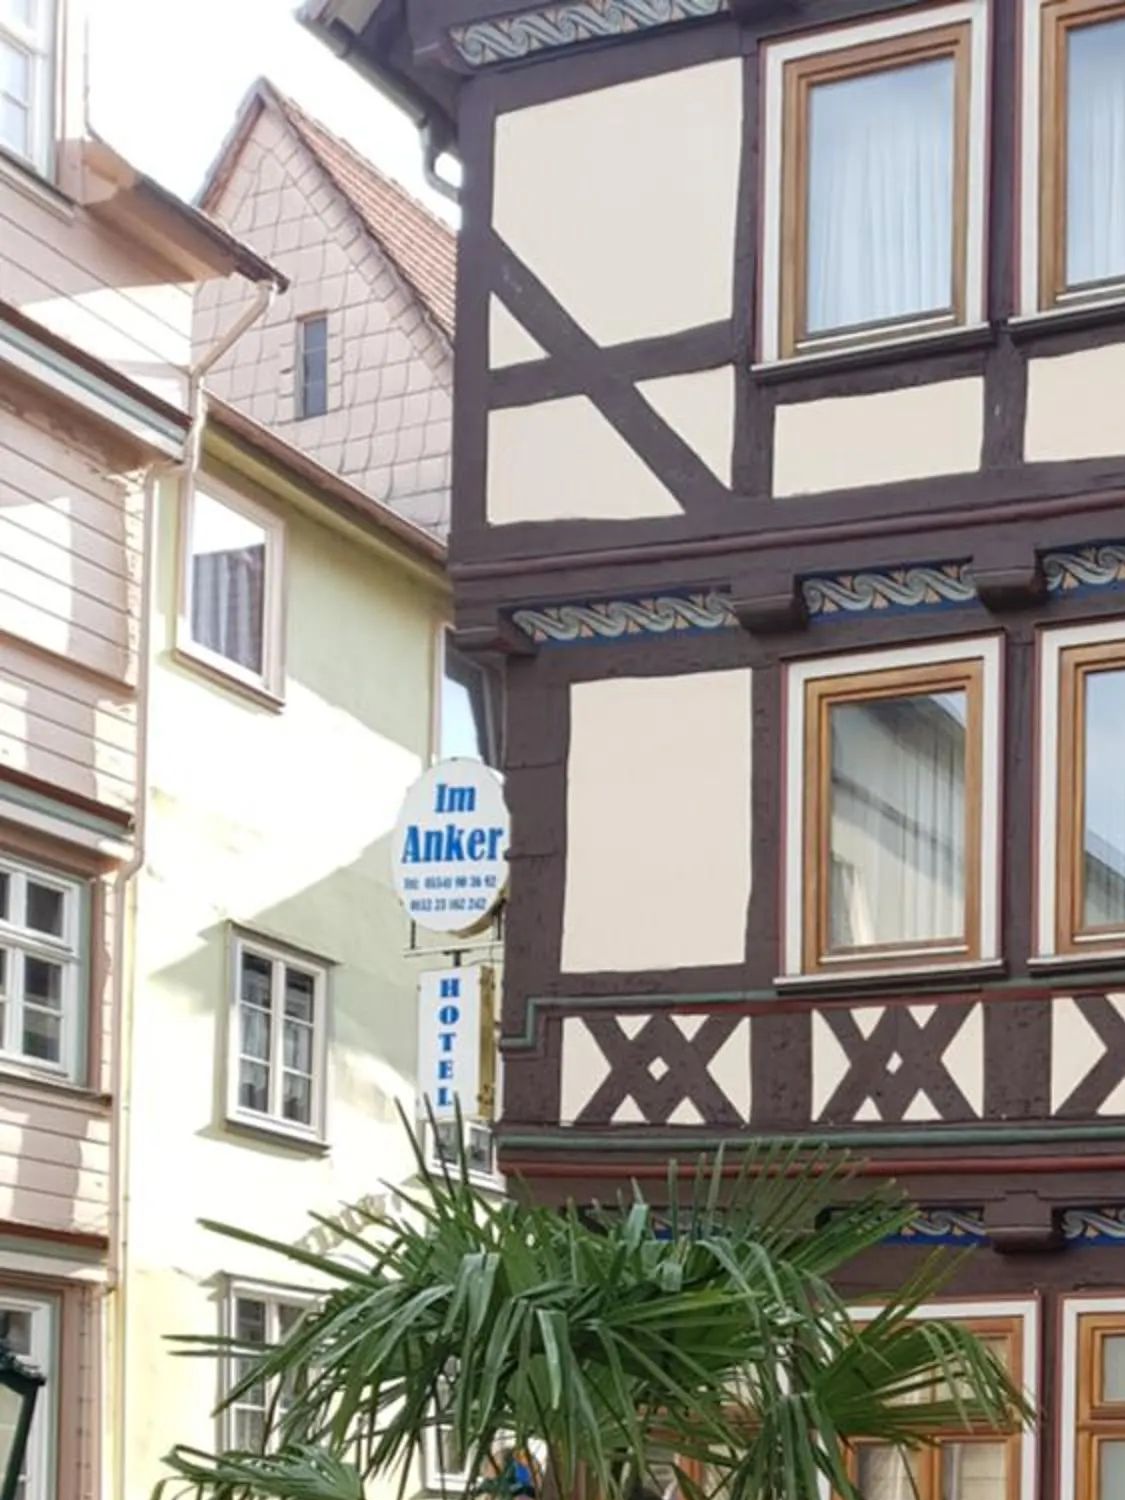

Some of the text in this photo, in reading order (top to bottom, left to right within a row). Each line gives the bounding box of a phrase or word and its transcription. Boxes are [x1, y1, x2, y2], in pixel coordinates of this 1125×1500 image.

[434, 783, 476, 813] Im
[401, 824, 503, 864] Anker
[437, 978, 461, 1107] HOTEL
